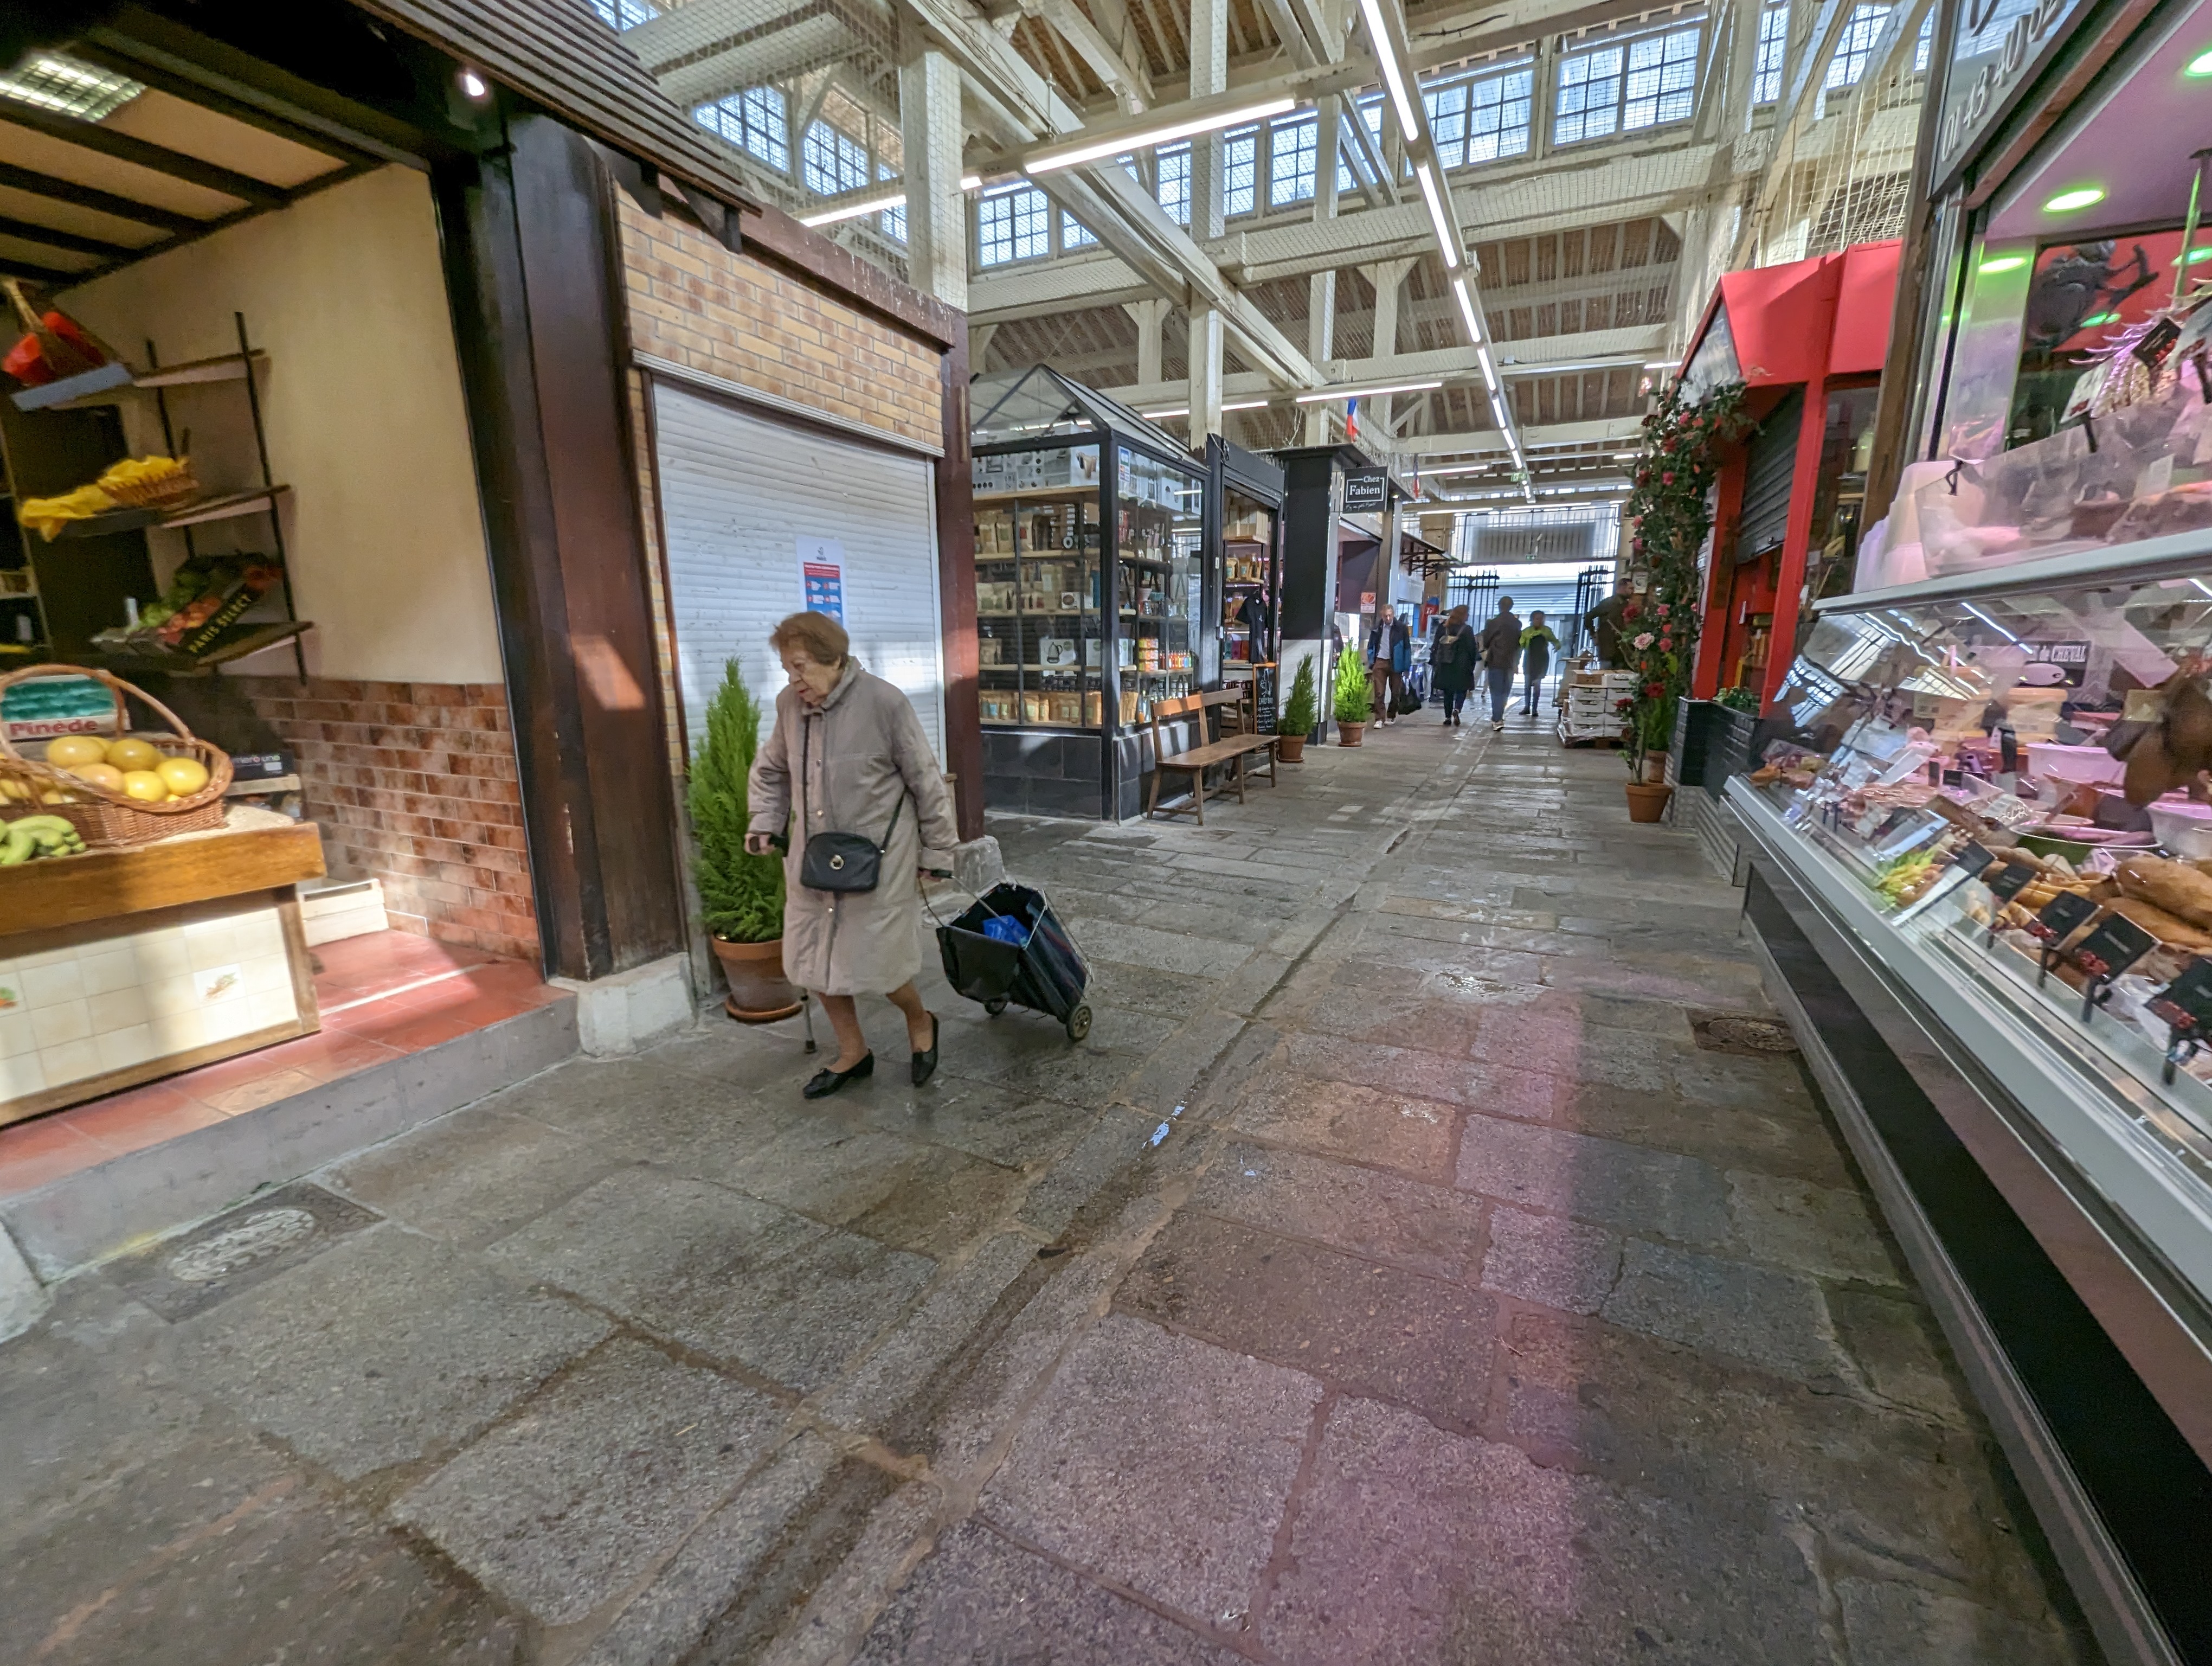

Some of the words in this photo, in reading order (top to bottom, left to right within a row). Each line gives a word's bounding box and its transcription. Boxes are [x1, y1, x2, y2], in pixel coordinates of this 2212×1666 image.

[1349, 485, 1381, 496] Fabien
[188, 625, 220, 653] PARIS
[216, 594, 252, 627] SELECT
[9, 719, 98, 736] Pinède
